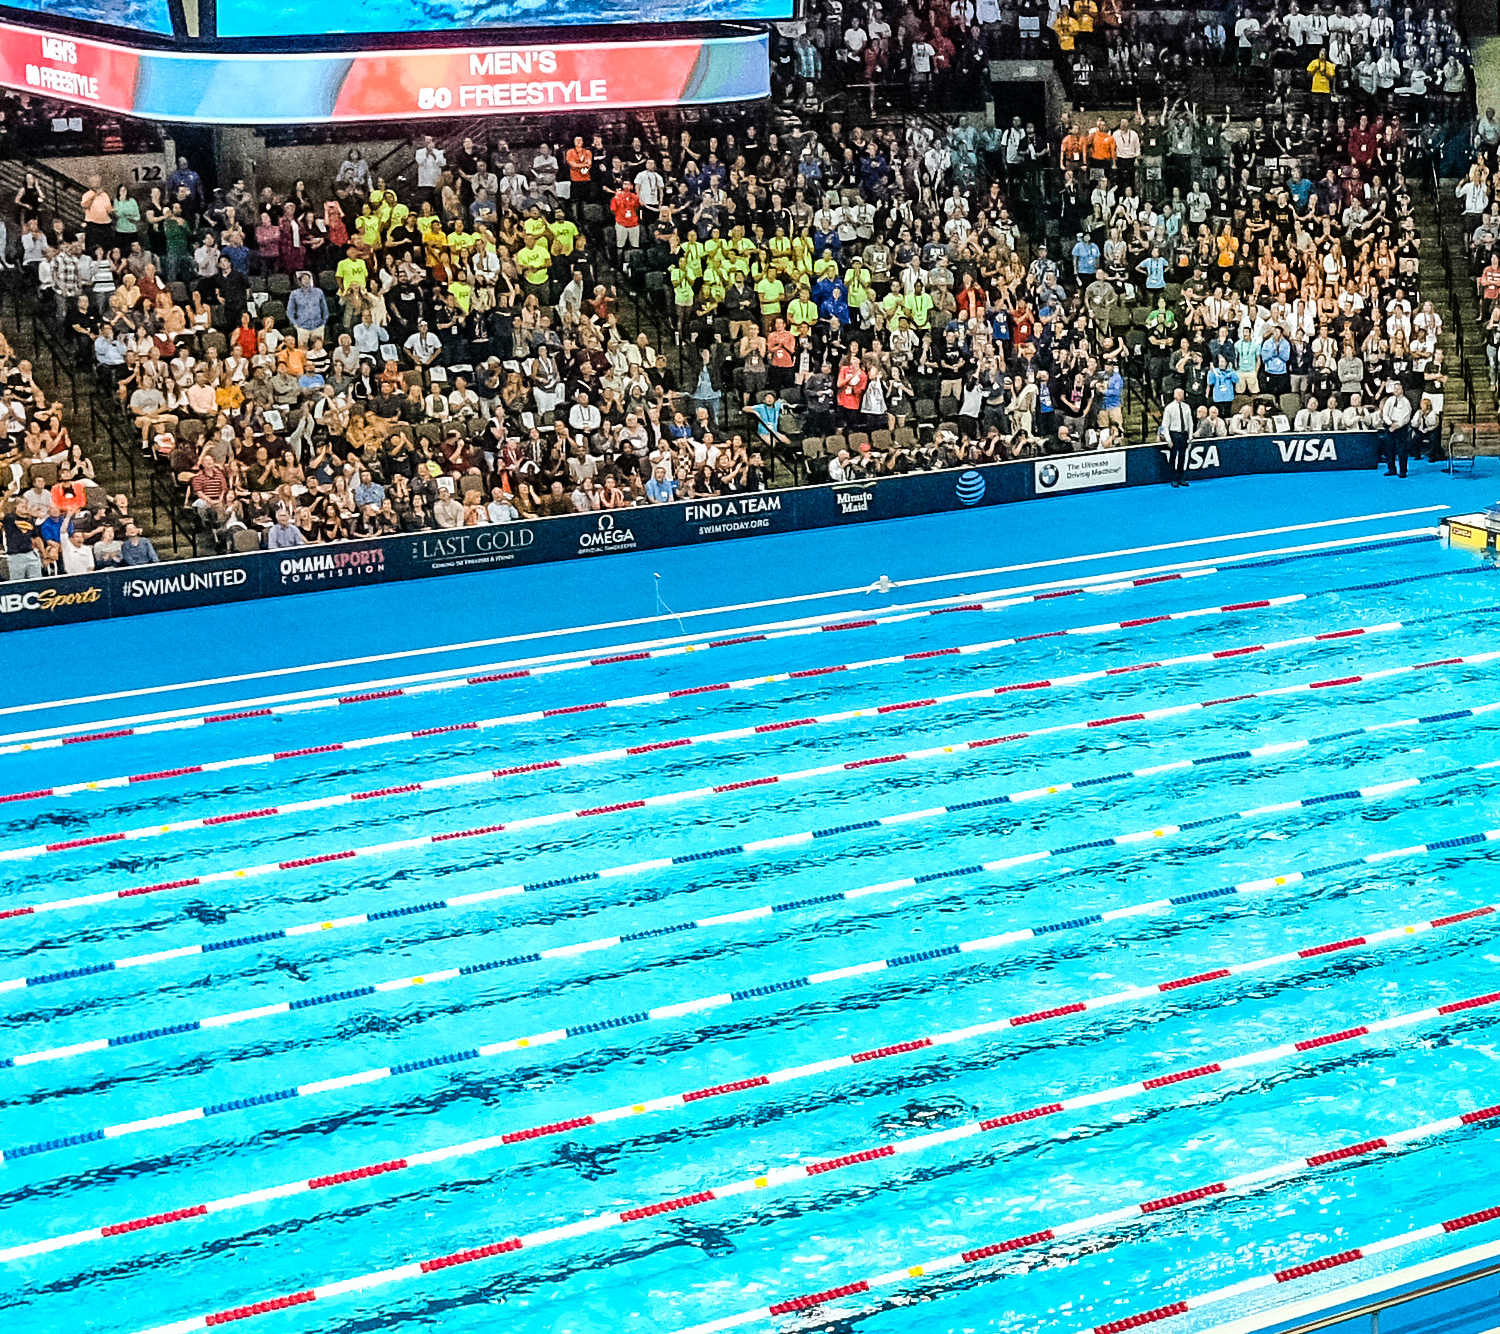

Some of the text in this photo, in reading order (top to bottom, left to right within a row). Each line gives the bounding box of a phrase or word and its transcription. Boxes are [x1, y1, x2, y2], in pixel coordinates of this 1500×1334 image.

[469, 52, 556, 75] MEN'S
[418, 80, 607, 109] 50 FREESTYLE
[131, 166, 161, 181] 122
[1272, 439, 1337, 462] VISA
[685, 496, 781, 521] FIND A TEAM
[842, 502, 867, 513] Maid
[423, 536, 469, 557] LAST
[477, 529, 533, 551] GOLD
[580, 529, 634, 546] OMEGA
[123, 569, 246, 597] #SWIMUNITED
[282, 564, 384, 584] COMMISSION
